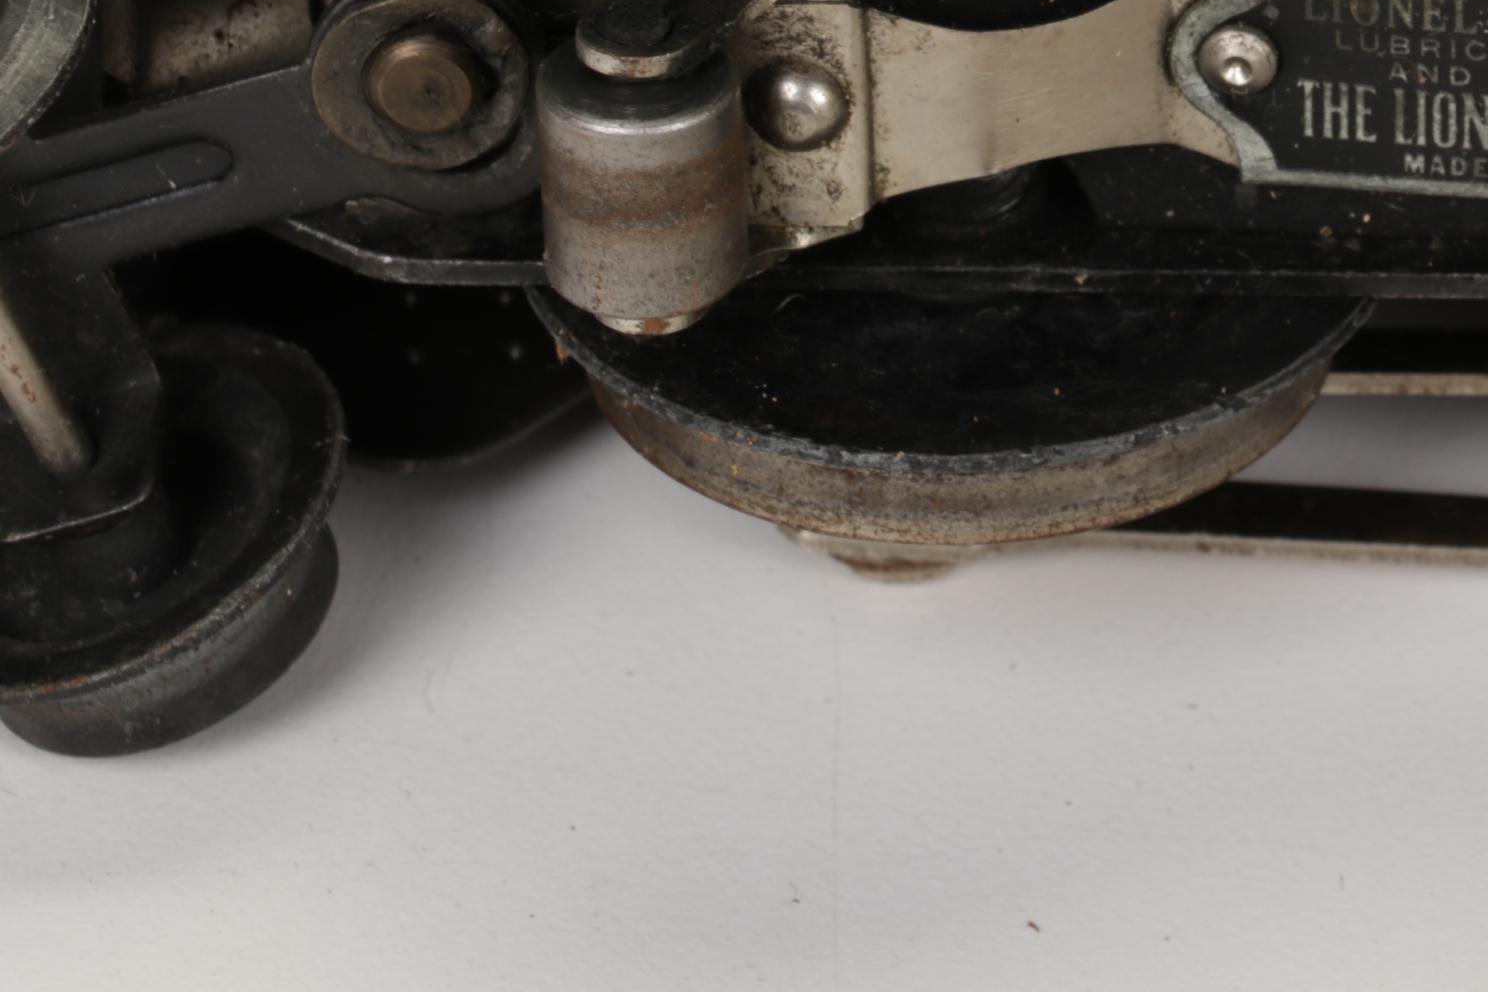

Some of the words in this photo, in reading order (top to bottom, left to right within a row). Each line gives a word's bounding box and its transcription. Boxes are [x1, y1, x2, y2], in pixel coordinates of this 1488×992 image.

[1389, 62, 1471, 86] AND
[1298, 78, 1377, 142] THE
[1404, 154, 1488, 179] MADE
